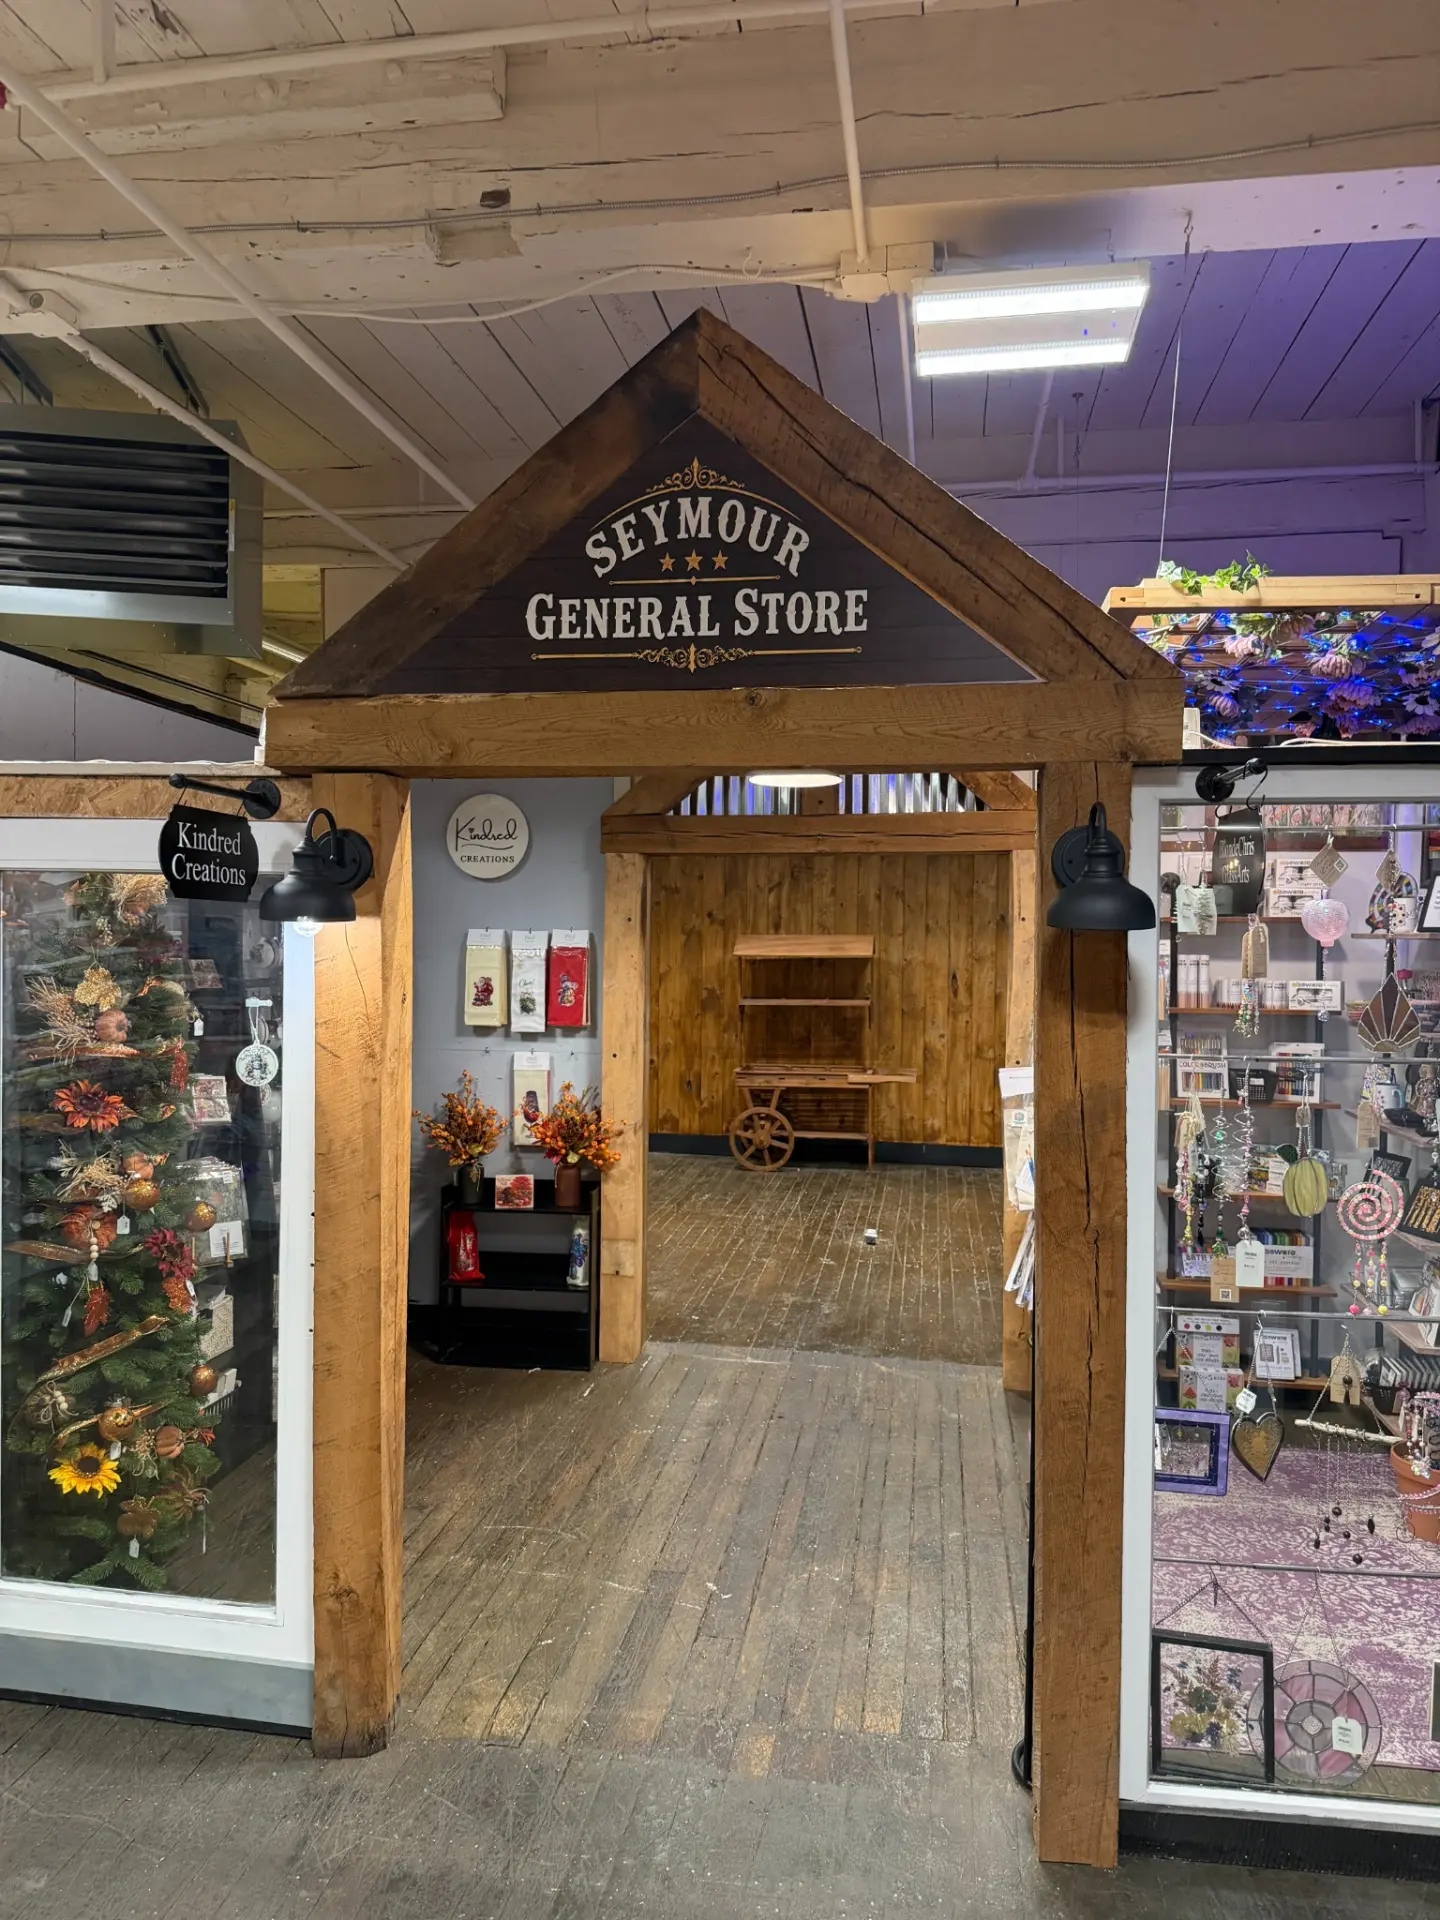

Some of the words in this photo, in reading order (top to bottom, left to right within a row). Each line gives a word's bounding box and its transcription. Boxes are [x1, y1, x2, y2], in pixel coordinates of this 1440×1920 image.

[585, 496, 810, 578] SEYMOUR
[525, 593, 720, 641] GENERAL
[734, 588, 868, 637] STORE
[177, 821, 242, 856] Kindred
[455, 816, 518, 852] Kindred
[171, 852, 247, 886] Creations
[460, 854, 515, 864] CREATIONS
